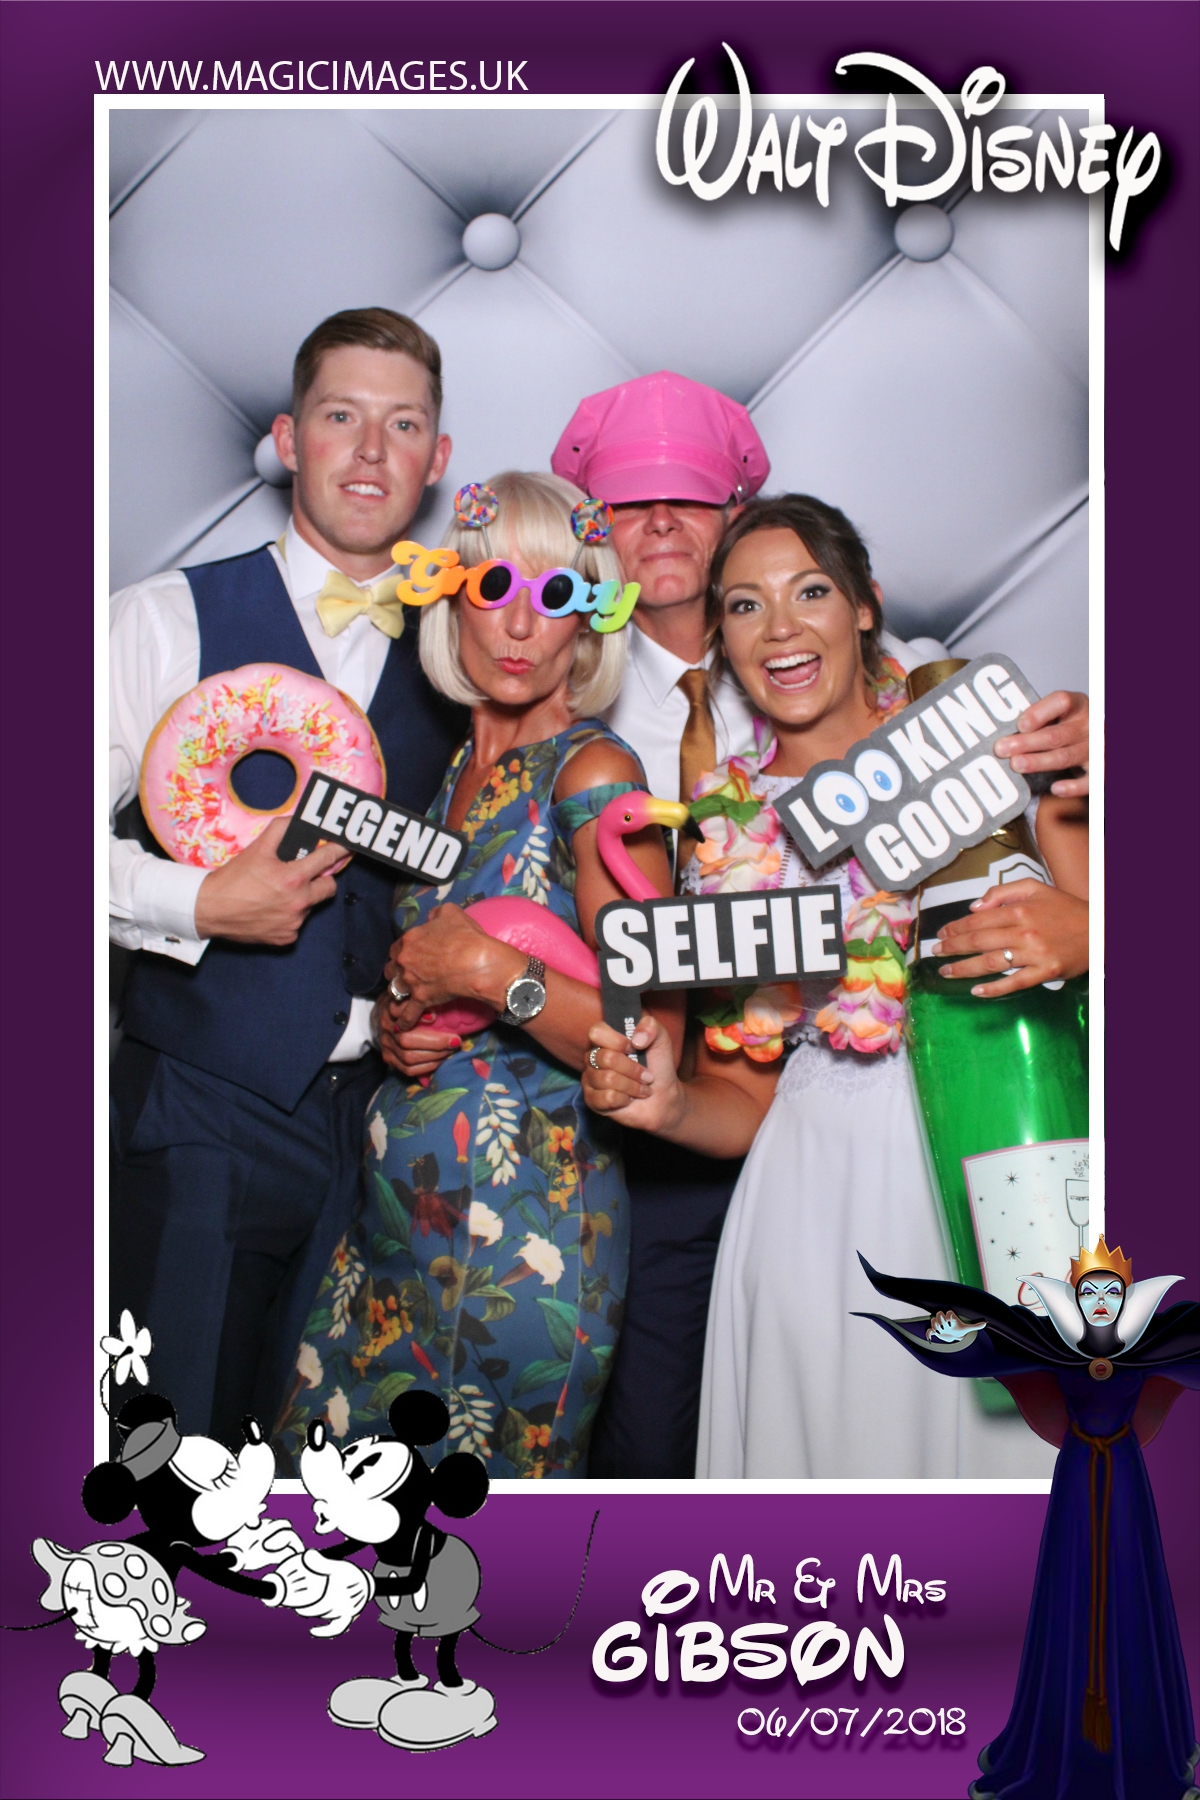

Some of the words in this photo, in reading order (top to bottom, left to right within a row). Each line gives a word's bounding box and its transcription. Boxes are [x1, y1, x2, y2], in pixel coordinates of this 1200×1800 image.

[300, 778, 462, 879] LEGEND
[865, 755, 1019, 881] GOOD
[601, 893, 840, 987] SELFIE
